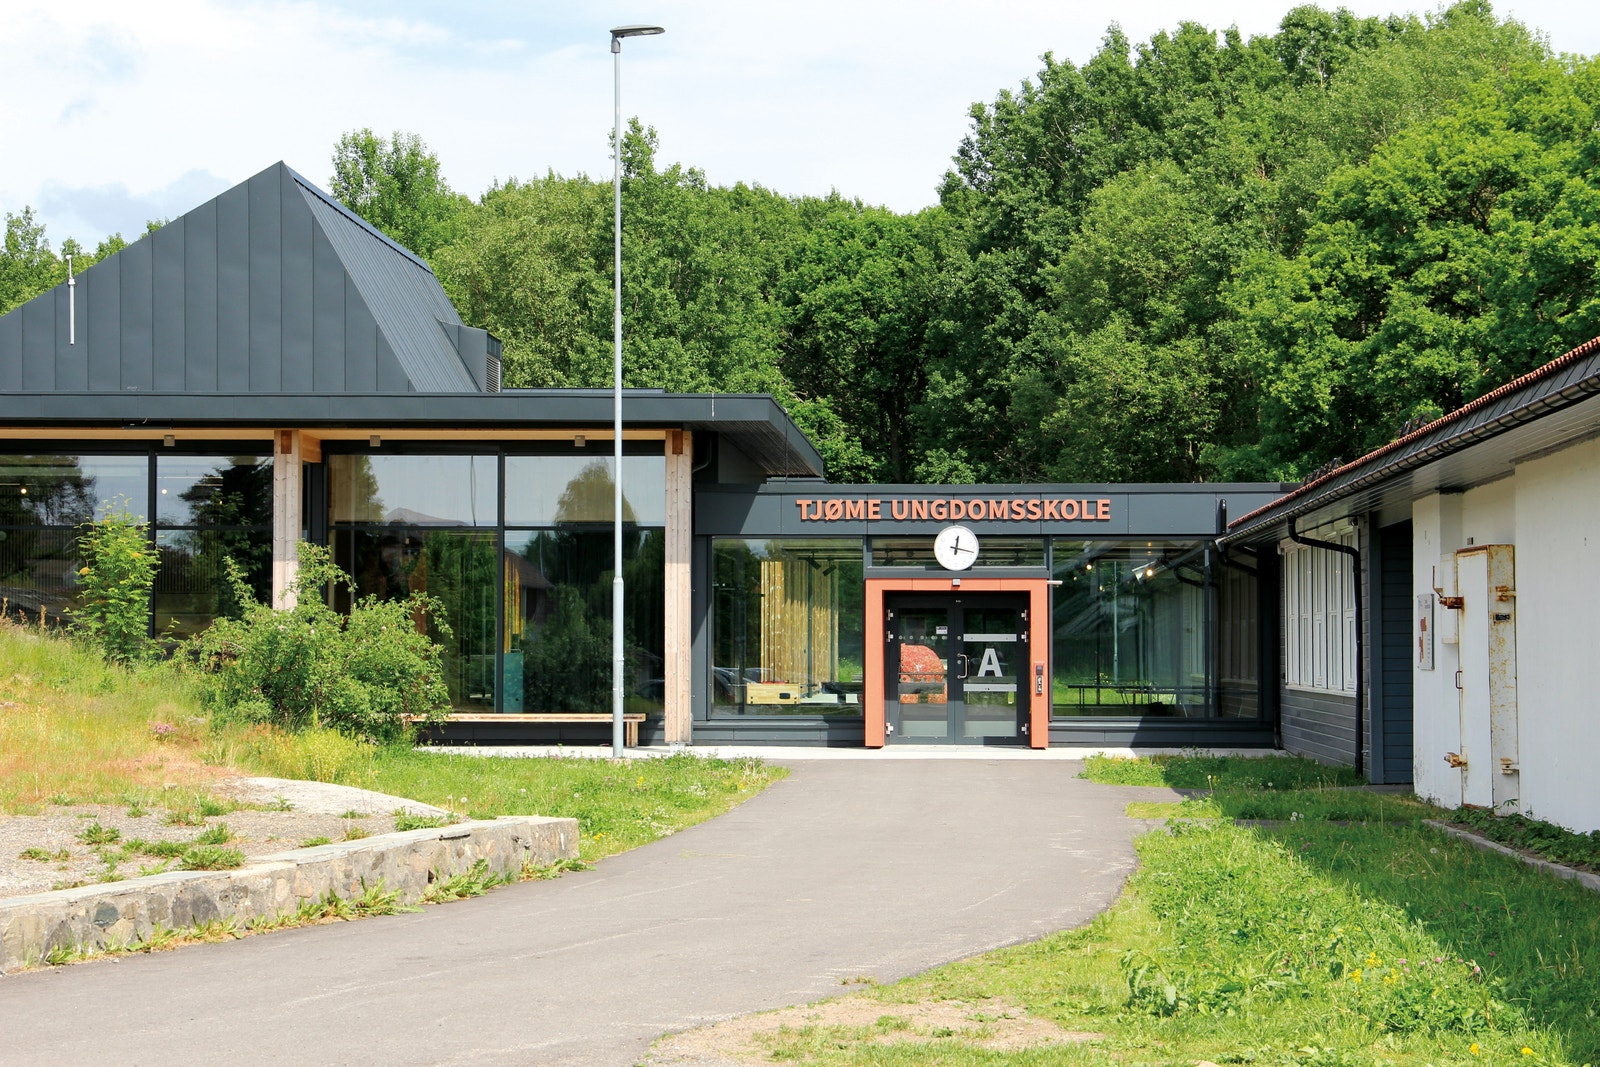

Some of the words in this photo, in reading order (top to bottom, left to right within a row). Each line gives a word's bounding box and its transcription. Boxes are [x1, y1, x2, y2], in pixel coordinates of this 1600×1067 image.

[796, 498, 882, 521] TJØME
[891, 498, 1111, 521] UNGDOMSSKOLE
[977, 648, 1003, 678] A
